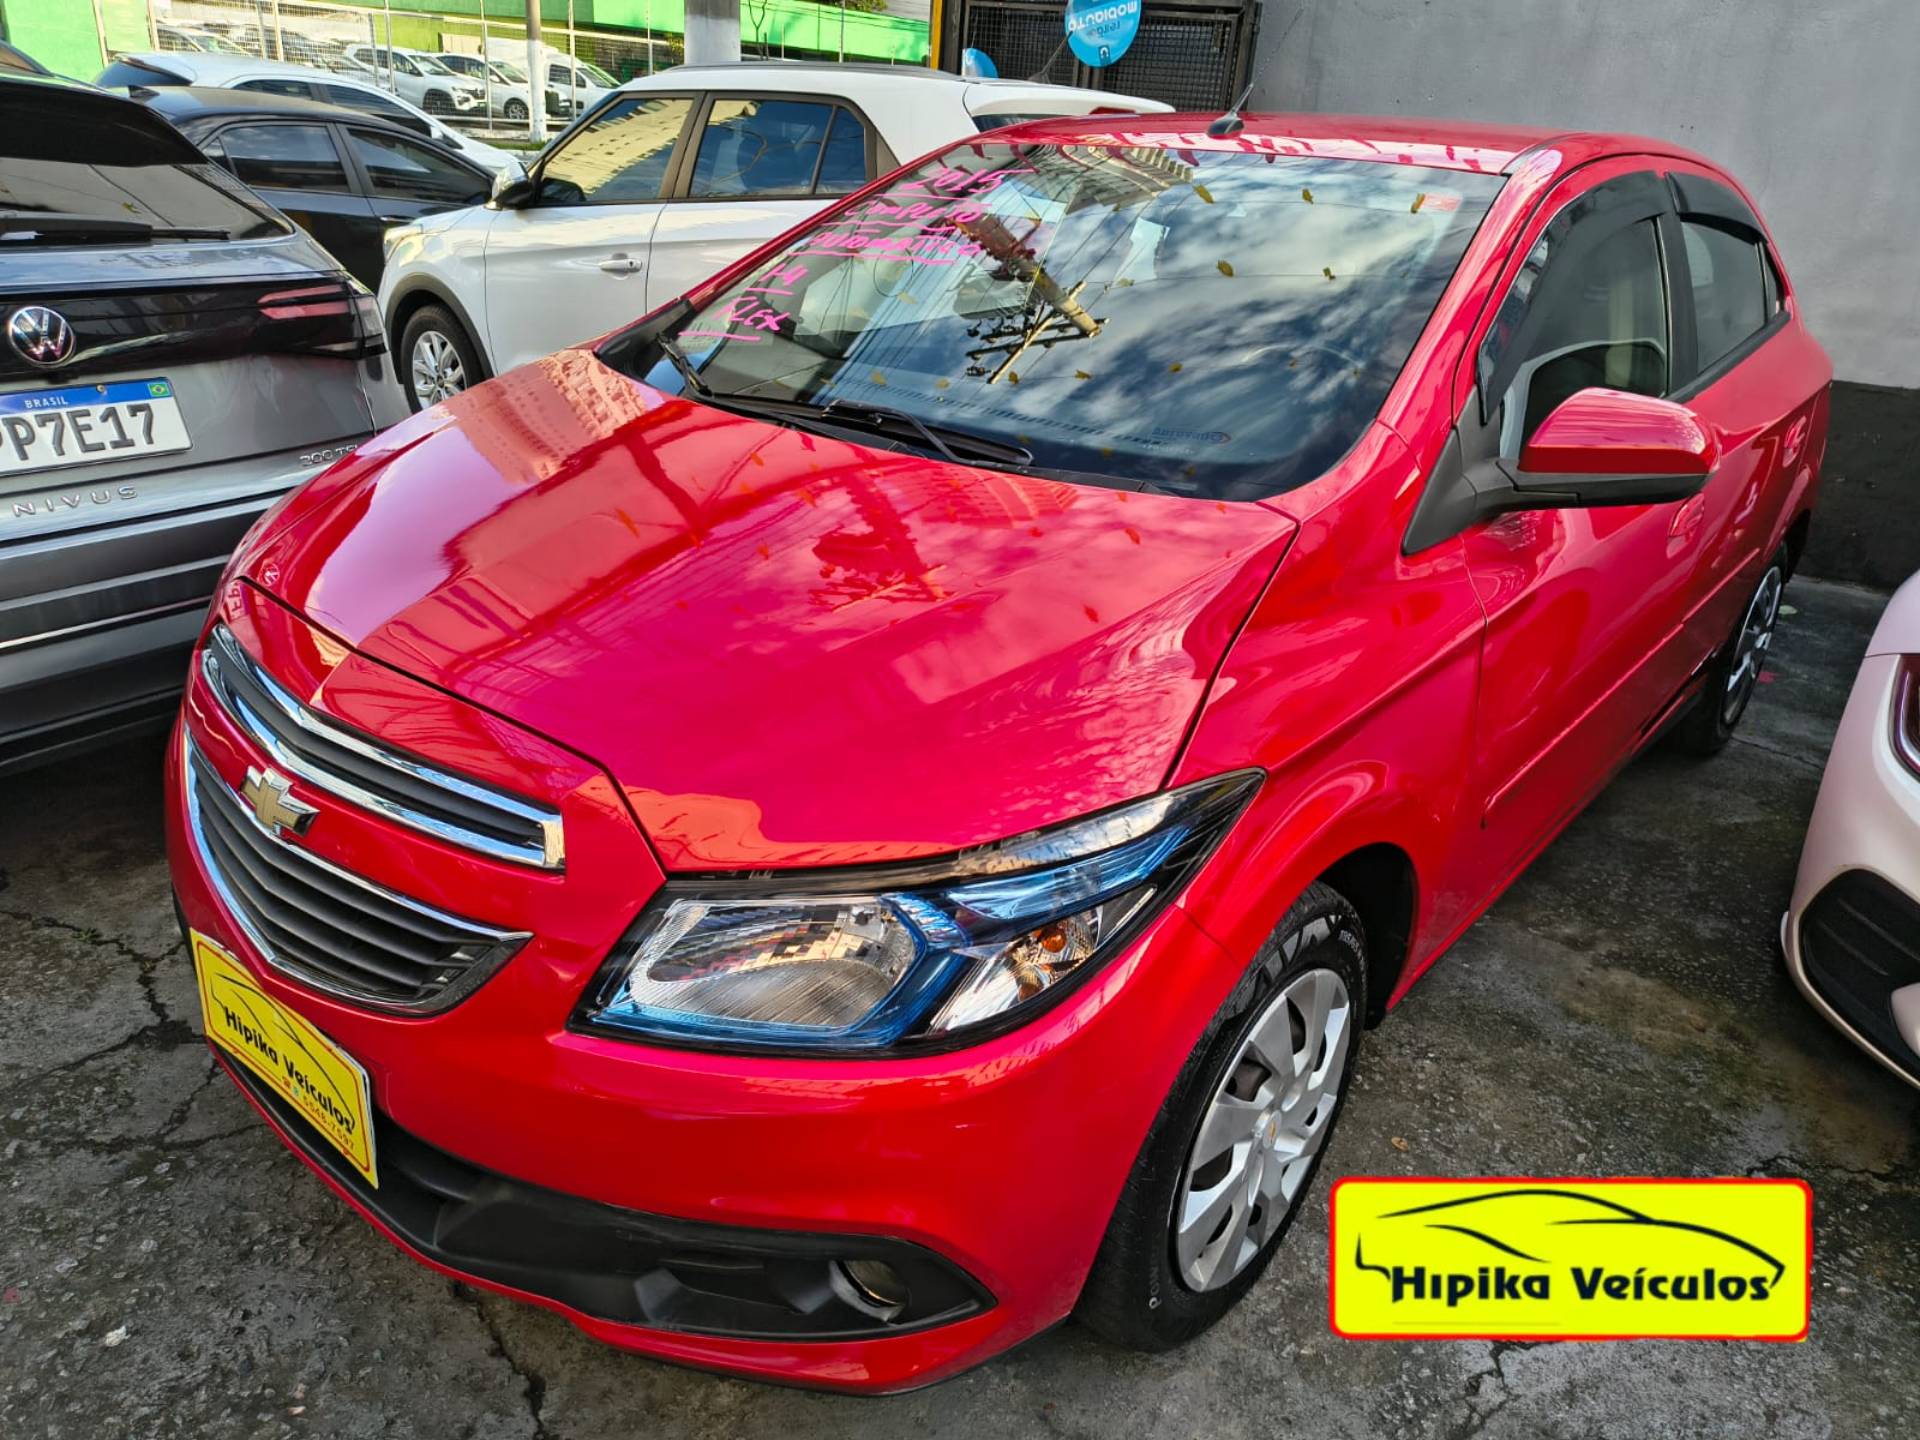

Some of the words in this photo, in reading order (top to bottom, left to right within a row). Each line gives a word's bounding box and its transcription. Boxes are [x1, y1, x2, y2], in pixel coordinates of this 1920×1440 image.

[901, 167, 1036, 194] 2015
[24, 396, 69, 410] BRASIL
[0, 402, 154, 462] P7E17
[299, 449, 334, 467] 200
[12, 485, 138, 517] NIVUS
[225, 1006, 279, 1066] Hipika
